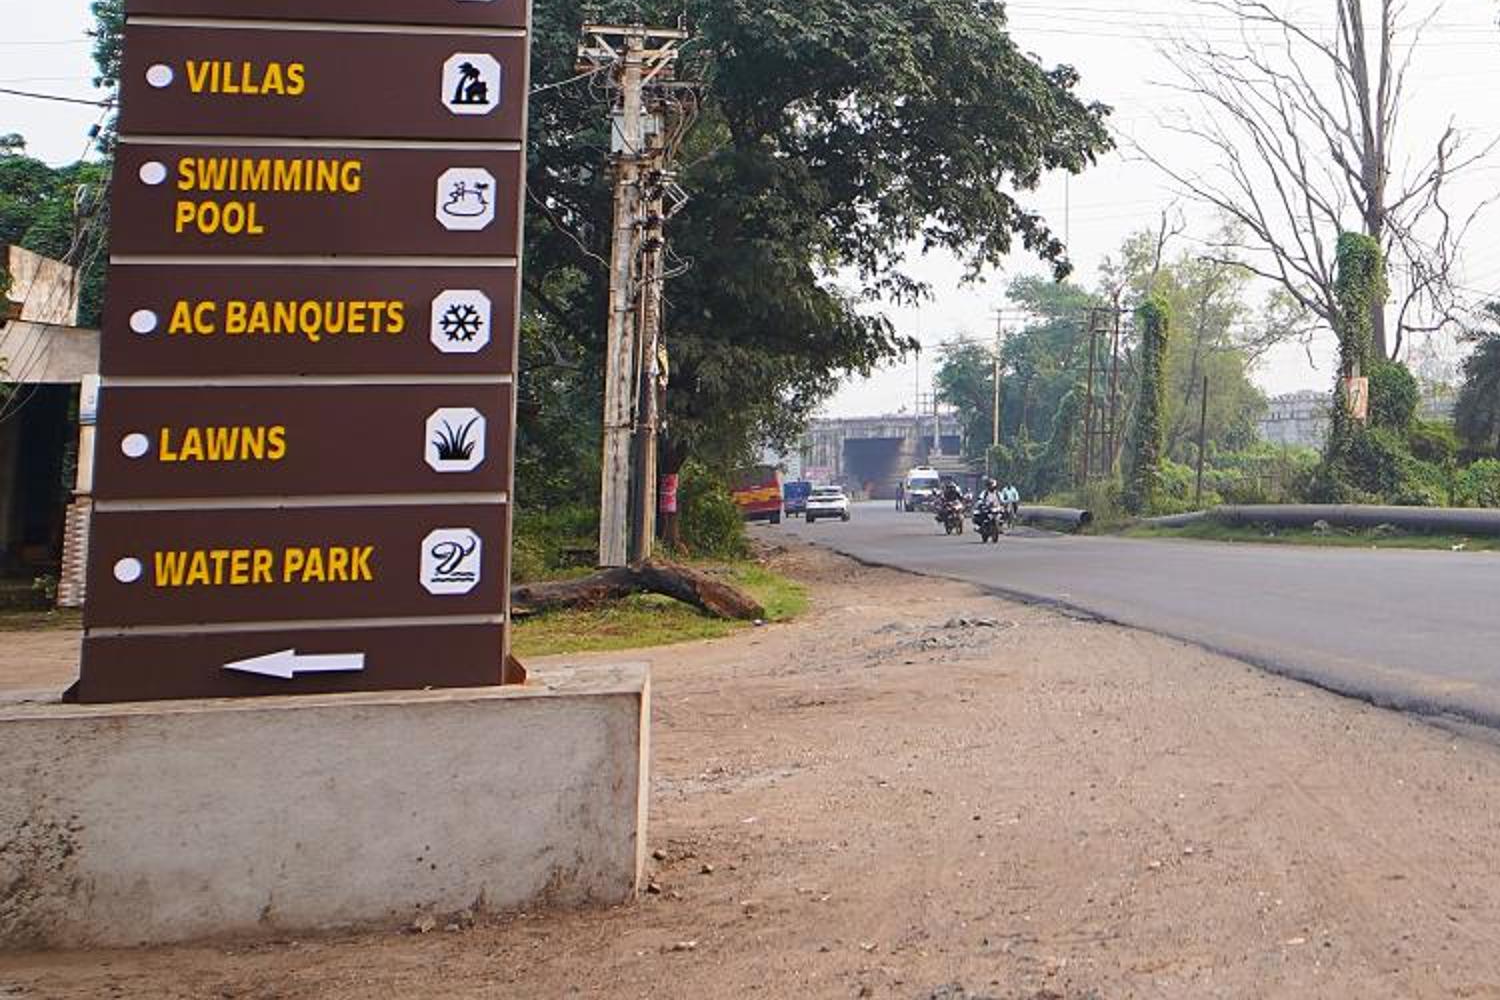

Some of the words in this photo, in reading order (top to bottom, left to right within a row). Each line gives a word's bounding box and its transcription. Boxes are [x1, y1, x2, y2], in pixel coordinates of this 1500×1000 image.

[186, 60, 305, 96] VILLAS
[176, 157, 361, 193] SWIMMING
[175, 200, 264, 234] POOL
[168, 301, 214, 335] AC
[225, 300, 405, 342] BANQUETS
[159, 425, 286, 462] LAWNS
[154, 547, 273, 587] WATER
[283, 545, 373, 583] PARK
